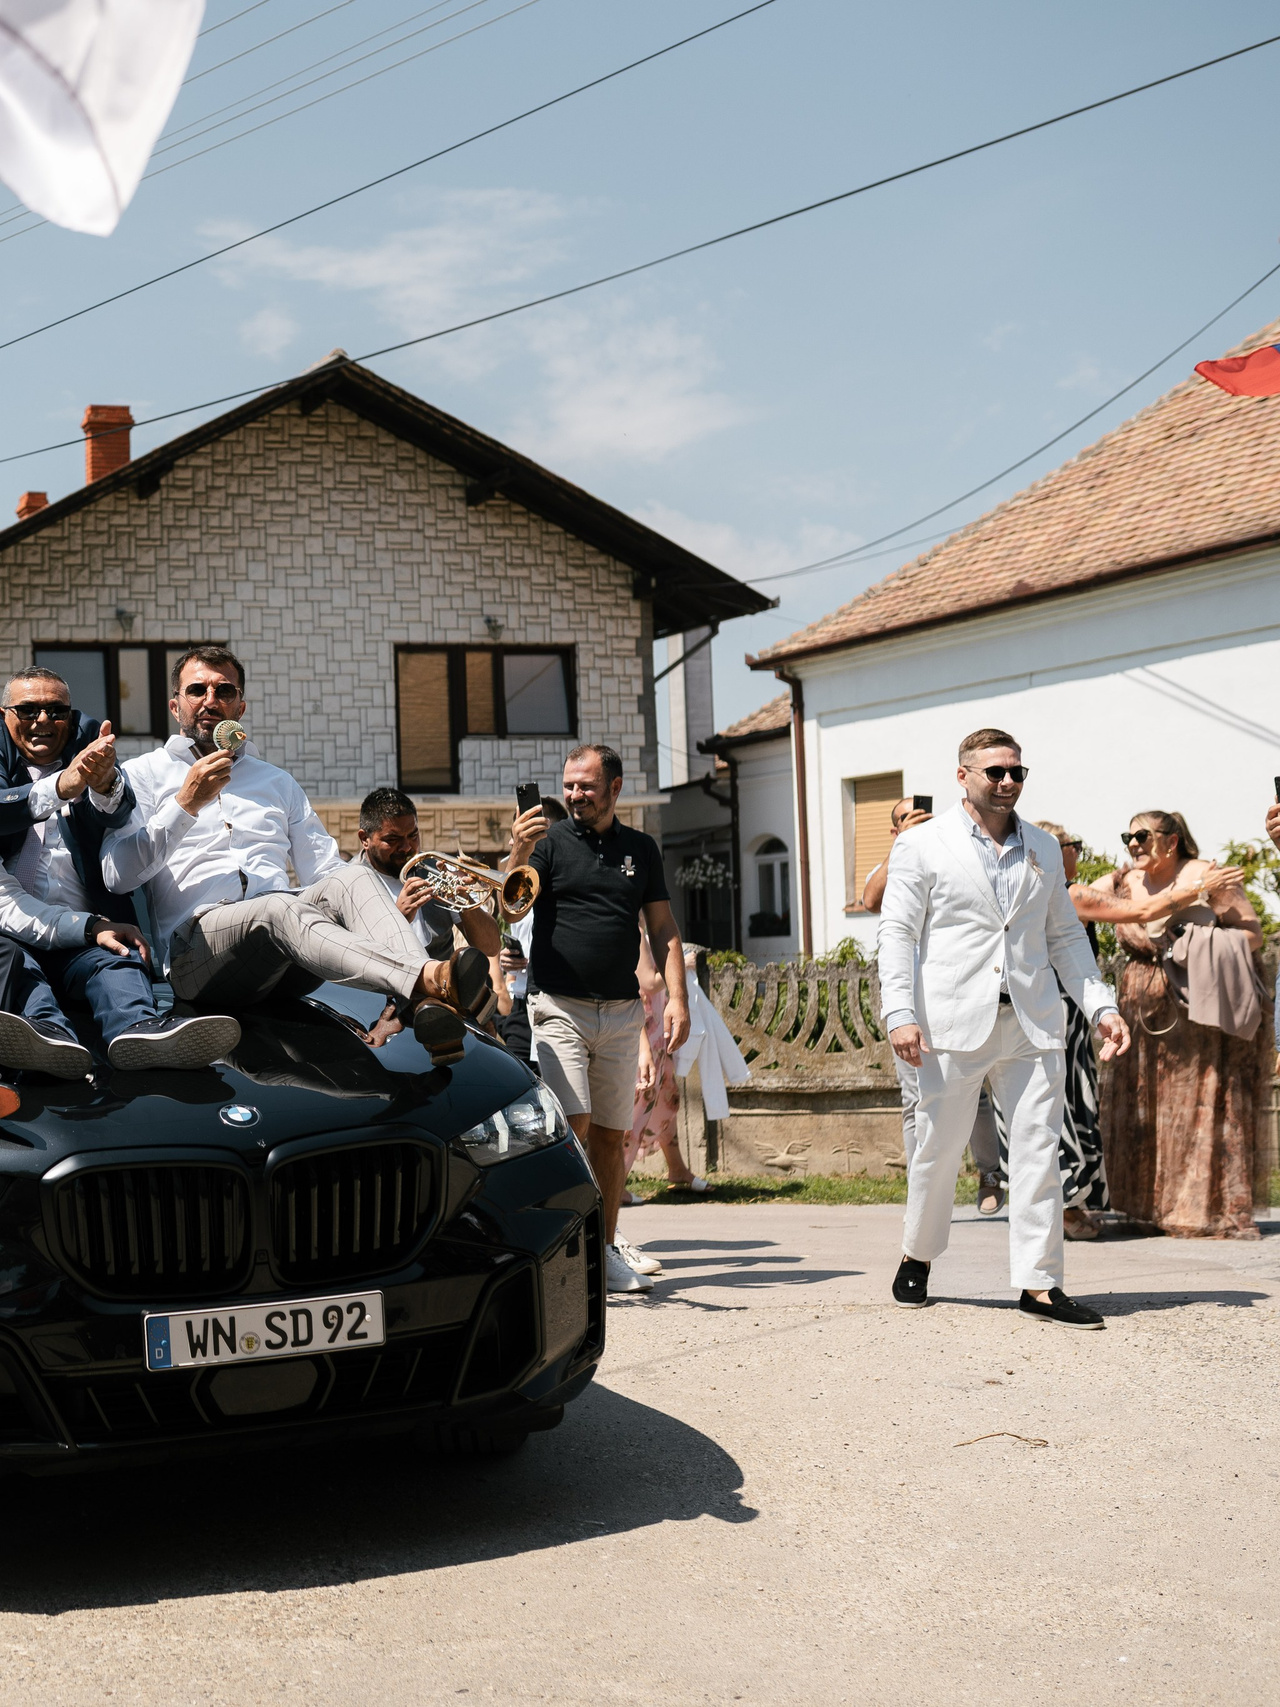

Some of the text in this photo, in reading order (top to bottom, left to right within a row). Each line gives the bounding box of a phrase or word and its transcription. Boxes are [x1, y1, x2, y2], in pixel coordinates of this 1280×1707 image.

[185, 1316, 237, 1359] WN
[264, 1308, 314, 1350] SD
[322, 1301, 368, 1344] 92
[155, 1347, 164, 1359] D
